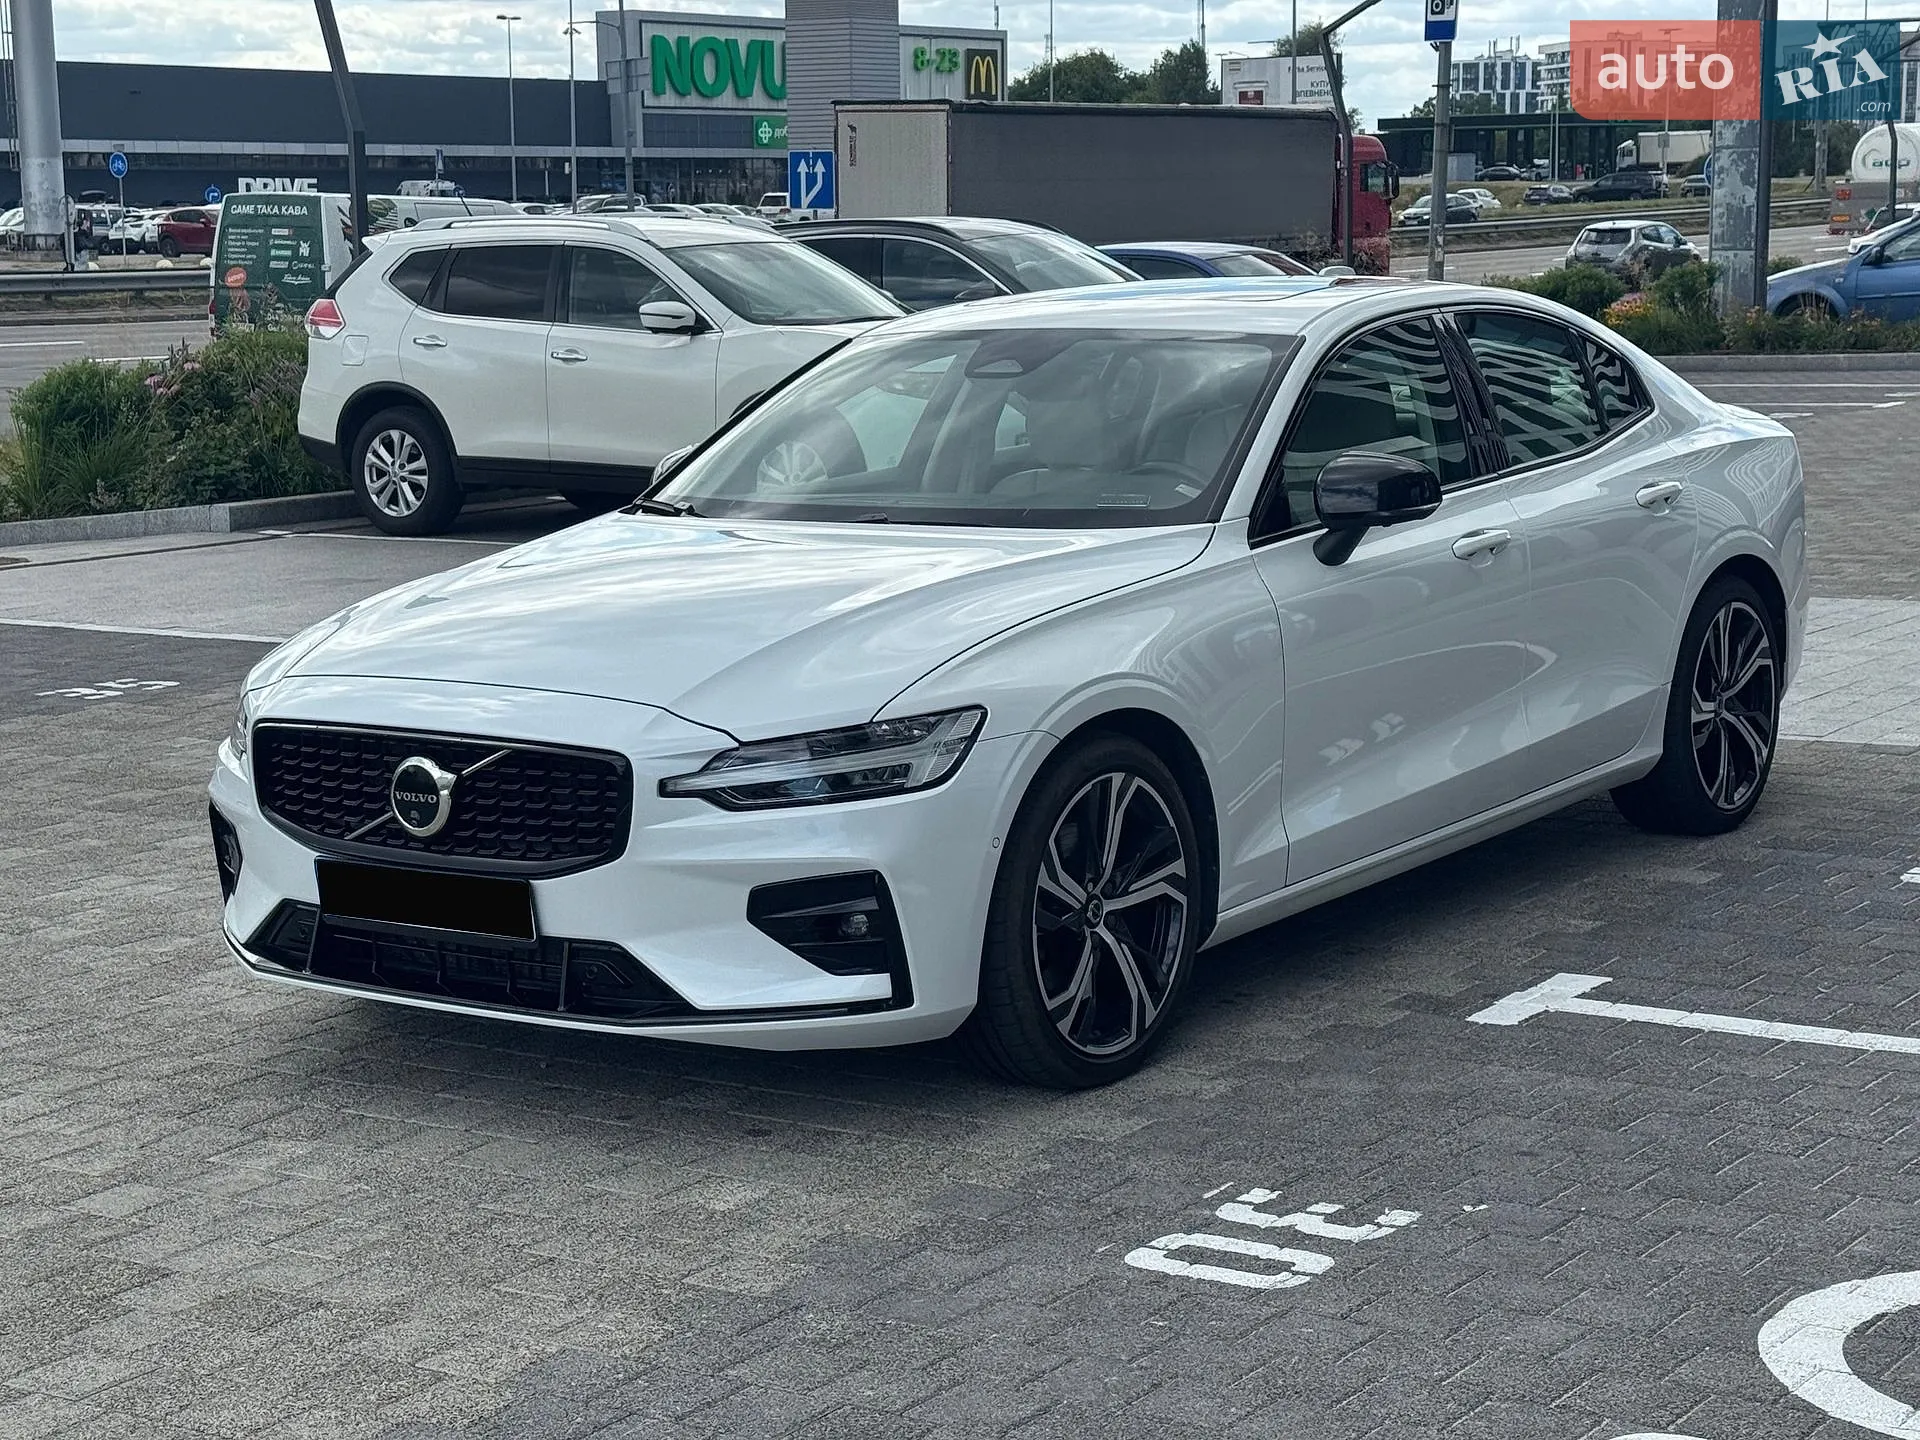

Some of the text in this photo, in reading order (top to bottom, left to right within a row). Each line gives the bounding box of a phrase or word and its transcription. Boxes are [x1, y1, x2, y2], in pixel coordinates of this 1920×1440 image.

[913, 46, 960, 72] 8-23
[238, 178, 318, 193] DRIVE
[256, 204, 280, 215] ТАКА
[281, 205, 308, 216] КАВА
[395, 791, 438, 804] VOLVO
